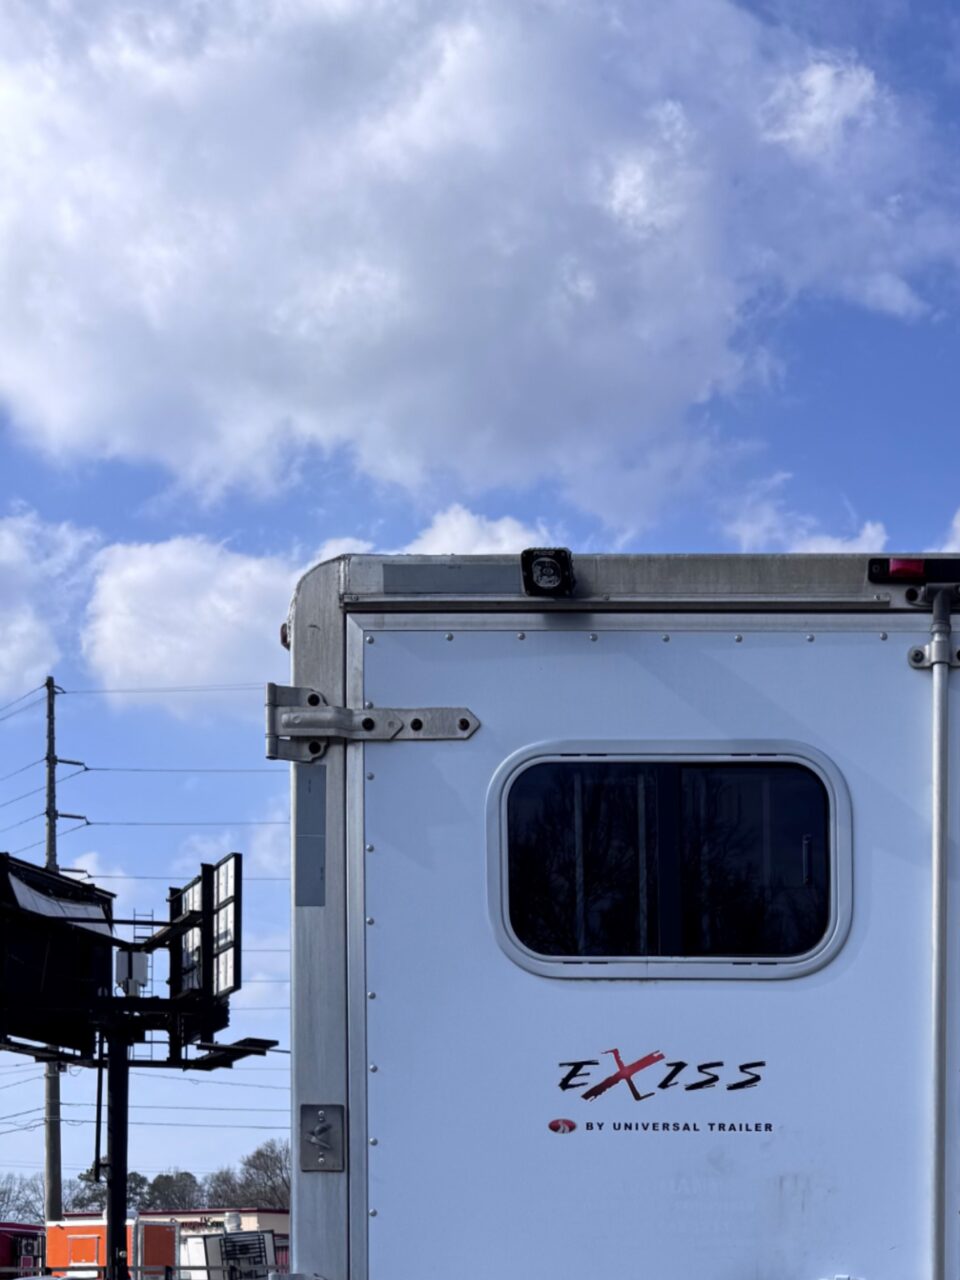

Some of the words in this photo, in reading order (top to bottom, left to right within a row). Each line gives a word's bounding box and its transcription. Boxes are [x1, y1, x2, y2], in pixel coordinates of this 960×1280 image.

[558, 1048, 766, 1101] EXISS
[585, 1121, 605, 1132] BY
[612, 1121, 701, 1132] UNIVERSAL
[708, 1122, 774, 1132] TRAILER
